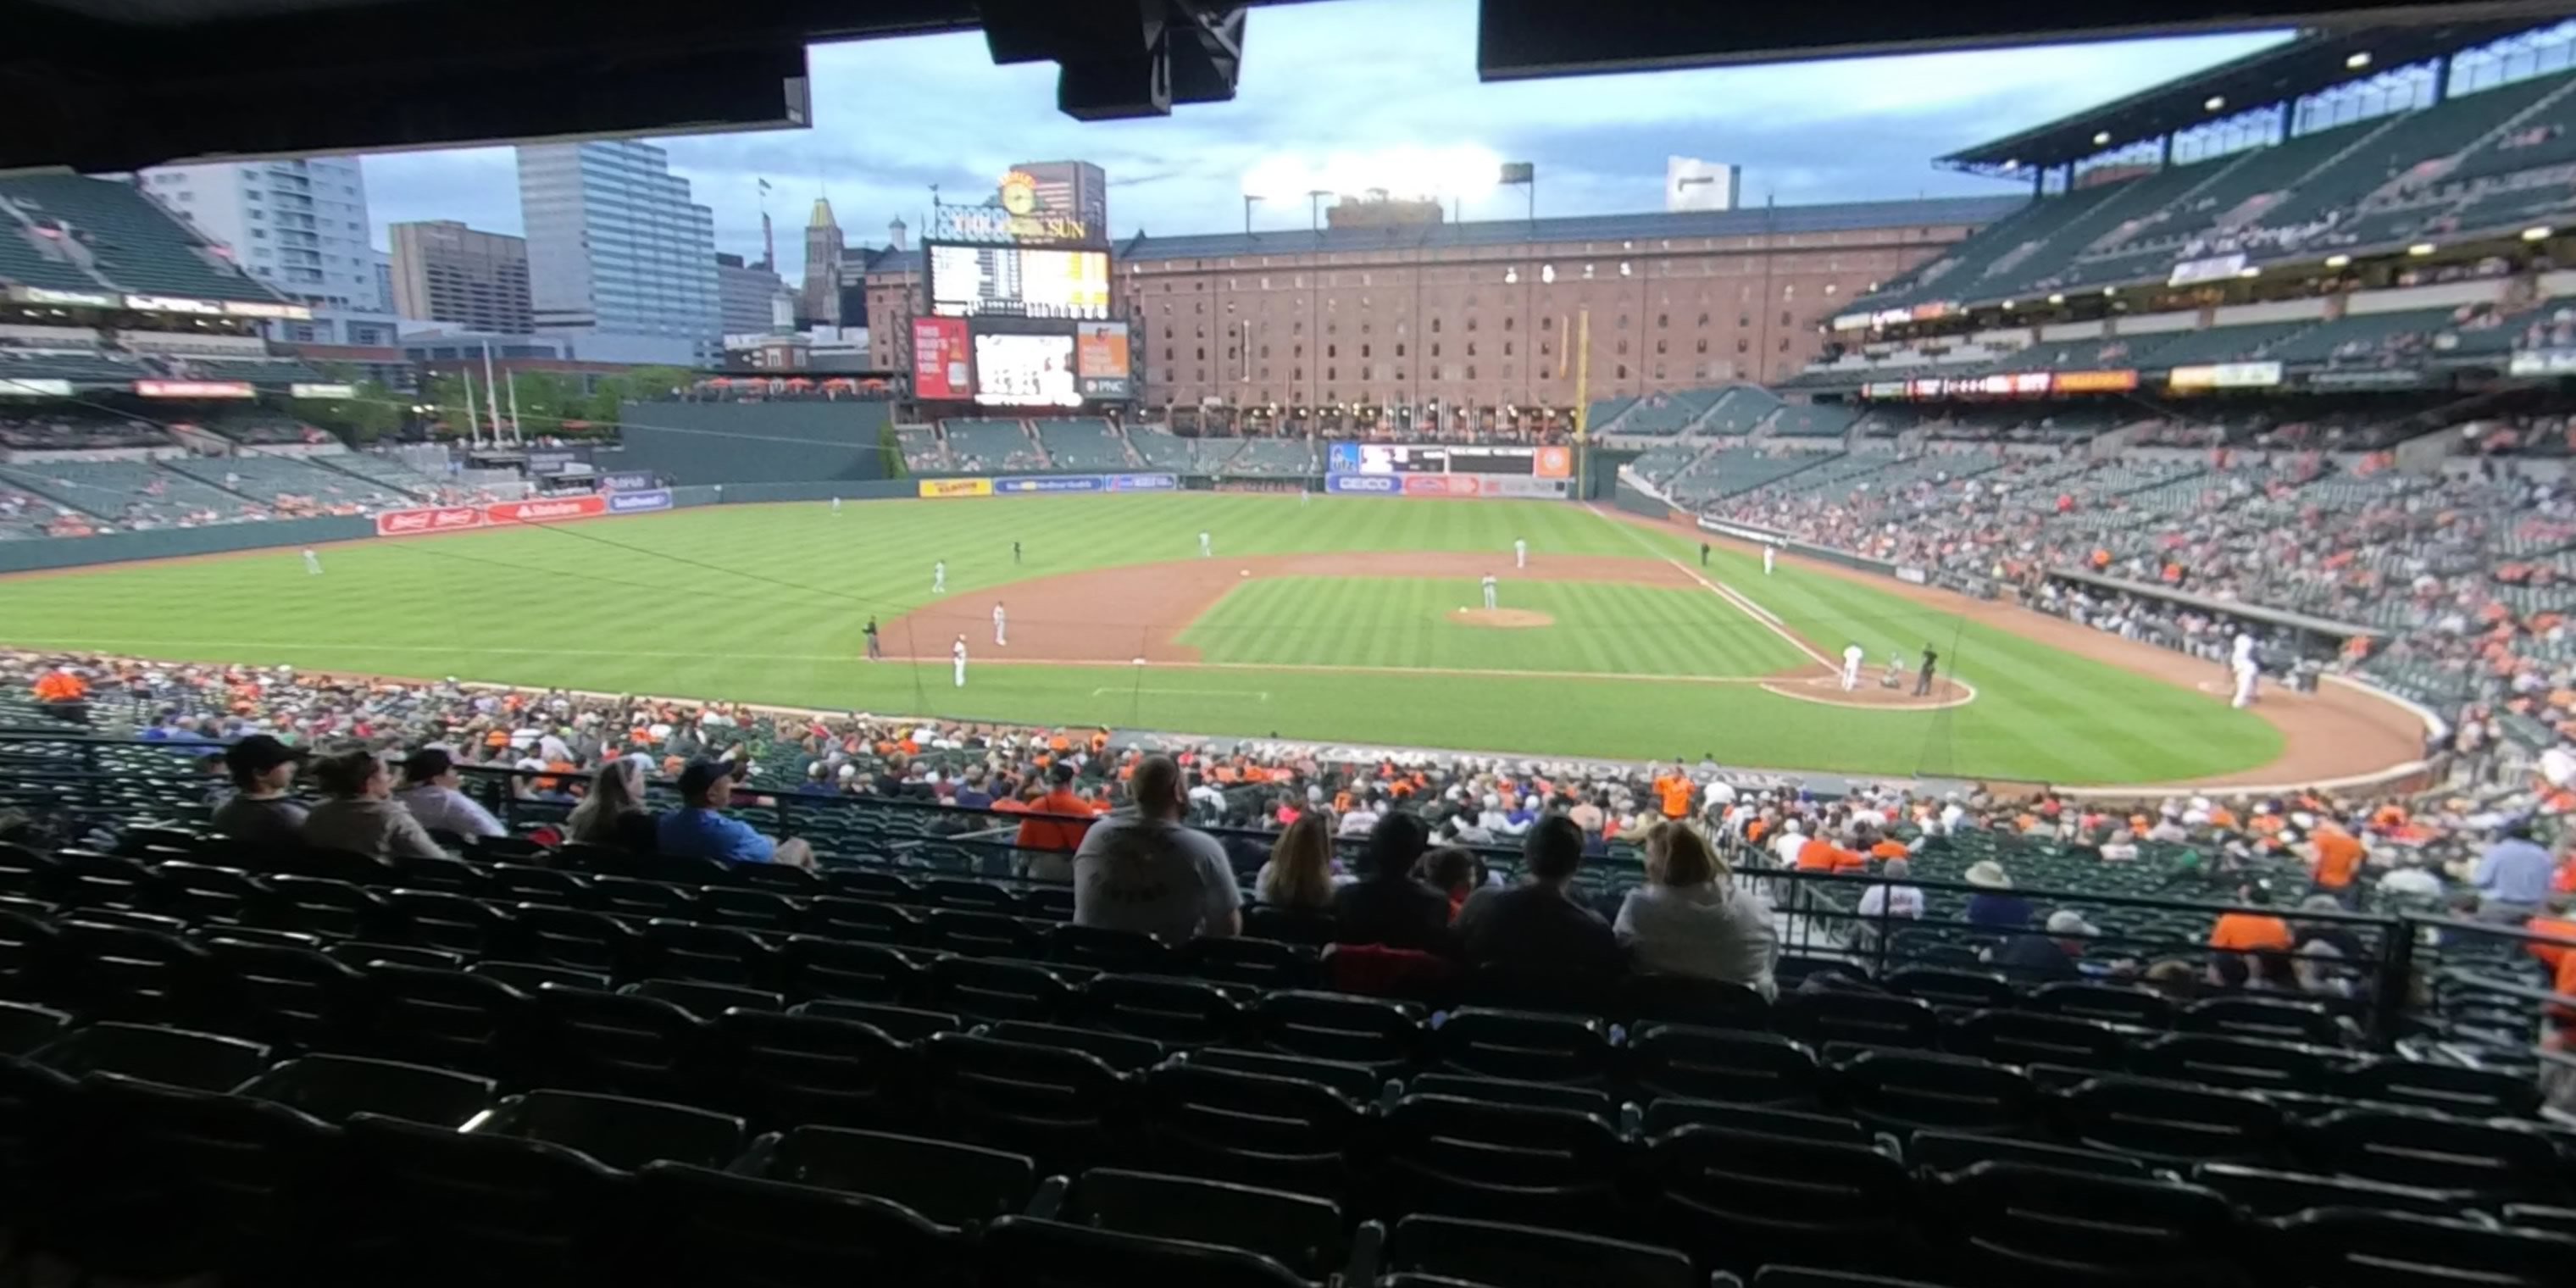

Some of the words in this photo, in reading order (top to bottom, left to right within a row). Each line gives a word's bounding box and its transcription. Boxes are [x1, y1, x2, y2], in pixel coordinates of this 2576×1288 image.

[1046, 216, 1085, 239] SUN
[1097, 380, 1124, 392] PNC
[1339, 477, 1391, 490] GEICO
